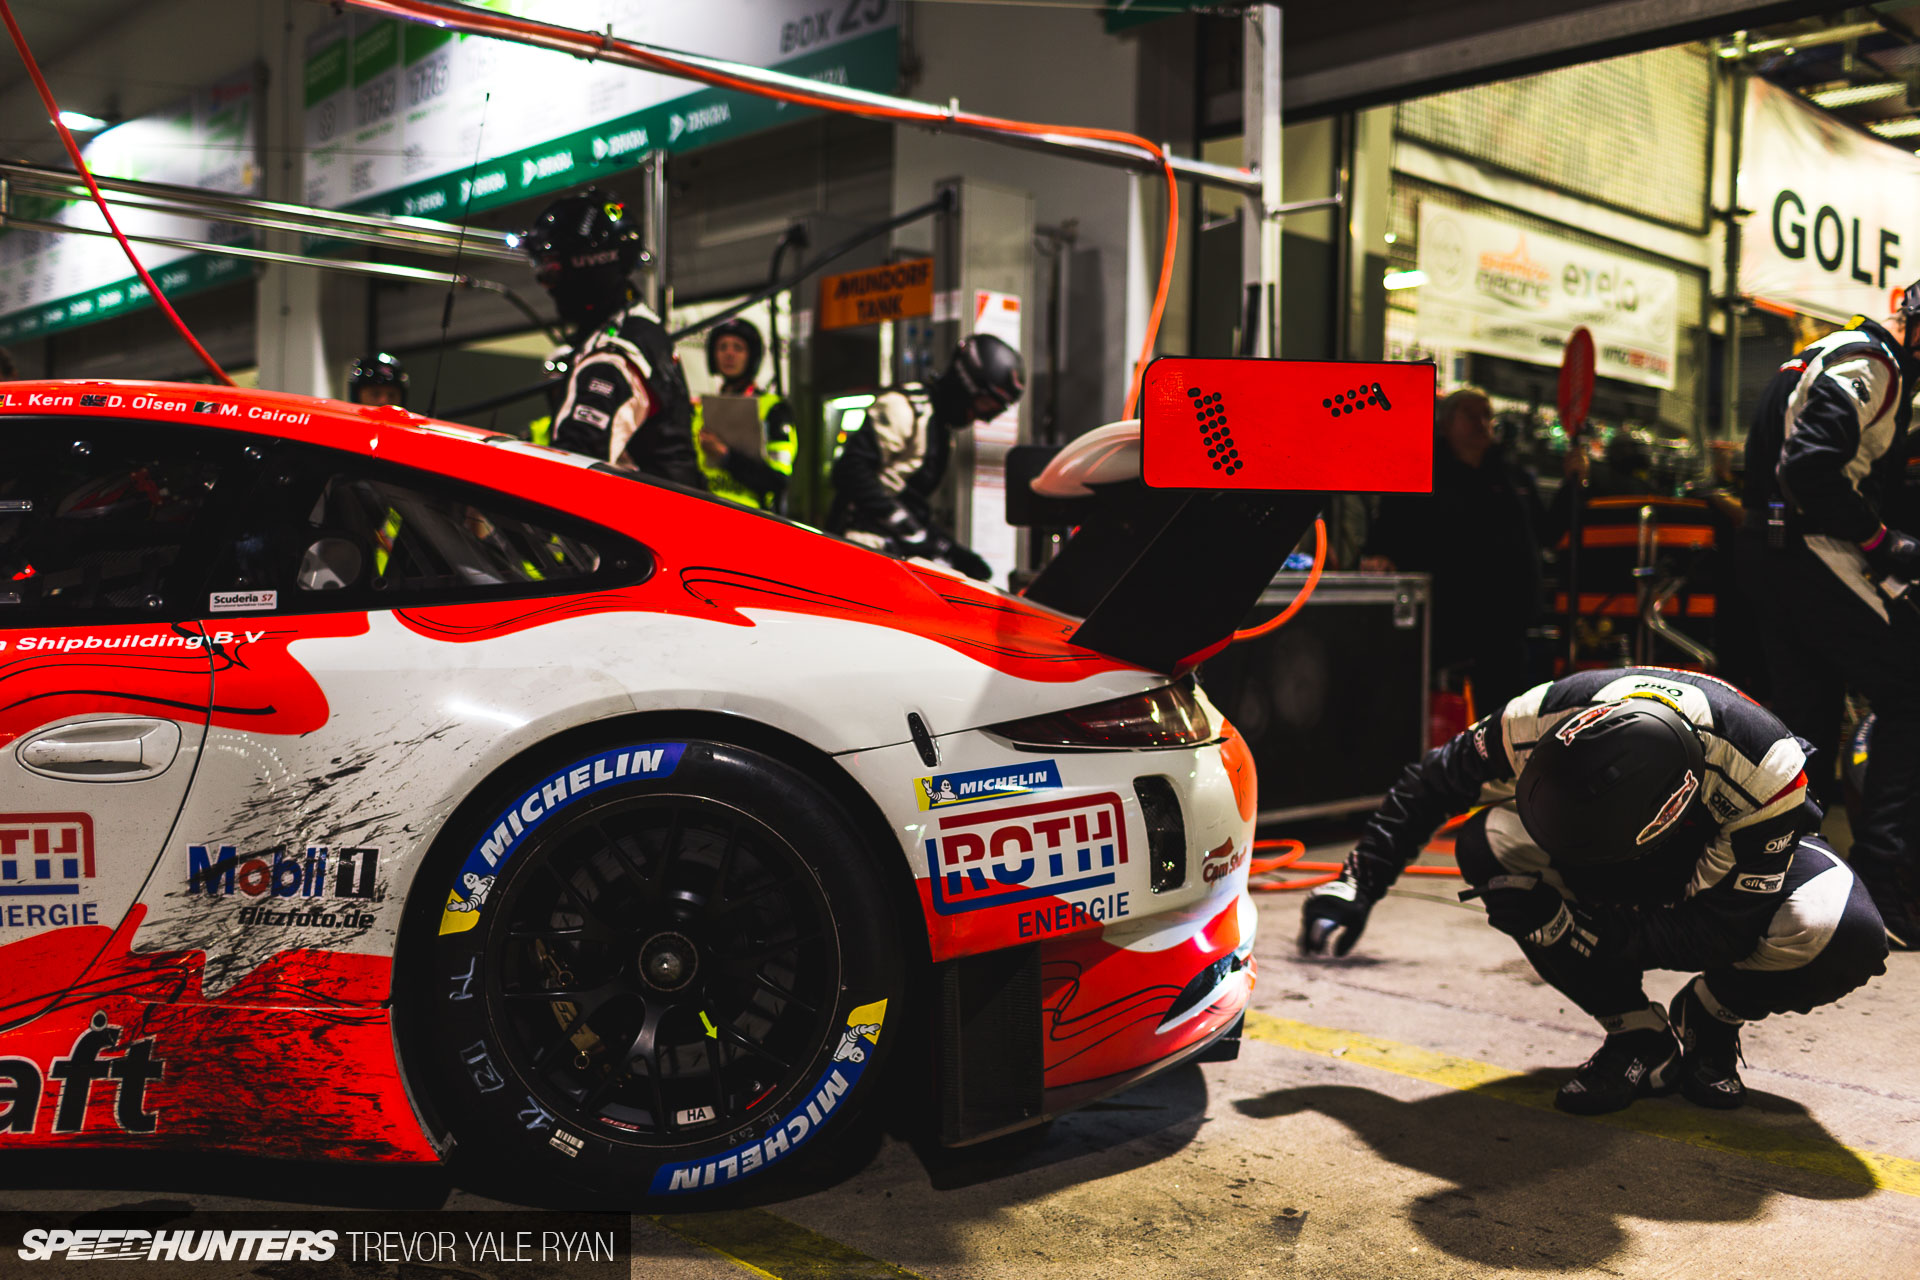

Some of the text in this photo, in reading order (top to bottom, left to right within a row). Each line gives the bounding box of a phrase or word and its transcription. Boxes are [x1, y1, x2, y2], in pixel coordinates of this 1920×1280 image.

[780, 10, 832, 53] BOX
[1772, 190, 1900, 289] GOLF
[571, 251, 619, 267] uvex
[835, 262, 929, 298] MUNDORF
[857, 294, 903, 319] TANK
[6, 394, 73, 406] L. Kern
[107, 396, 187, 412] D. Olsen
[220, 404, 311, 425] M. Cairoli
[214, 594, 259, 604] Scuderia
[16, 634, 203, 652] Shipbuilding
[213, 631, 265, 644] B.V
[960, 771, 1047, 795] MICHELIN
[480, 749, 664, 868] MICHELIN
[1710, 791, 1743, 819] OMP
[941, 810, 1115, 896] ROTH
[1765, 834, 1793, 852] OMP
[189, 846, 328, 898] Mobil
[0, 904, 98, 927] ERGIE
[1018, 891, 1130, 938] ENERGIE
[687, 1108, 707, 1122] HA
[669, 1069, 849, 1191] MICHELIN
